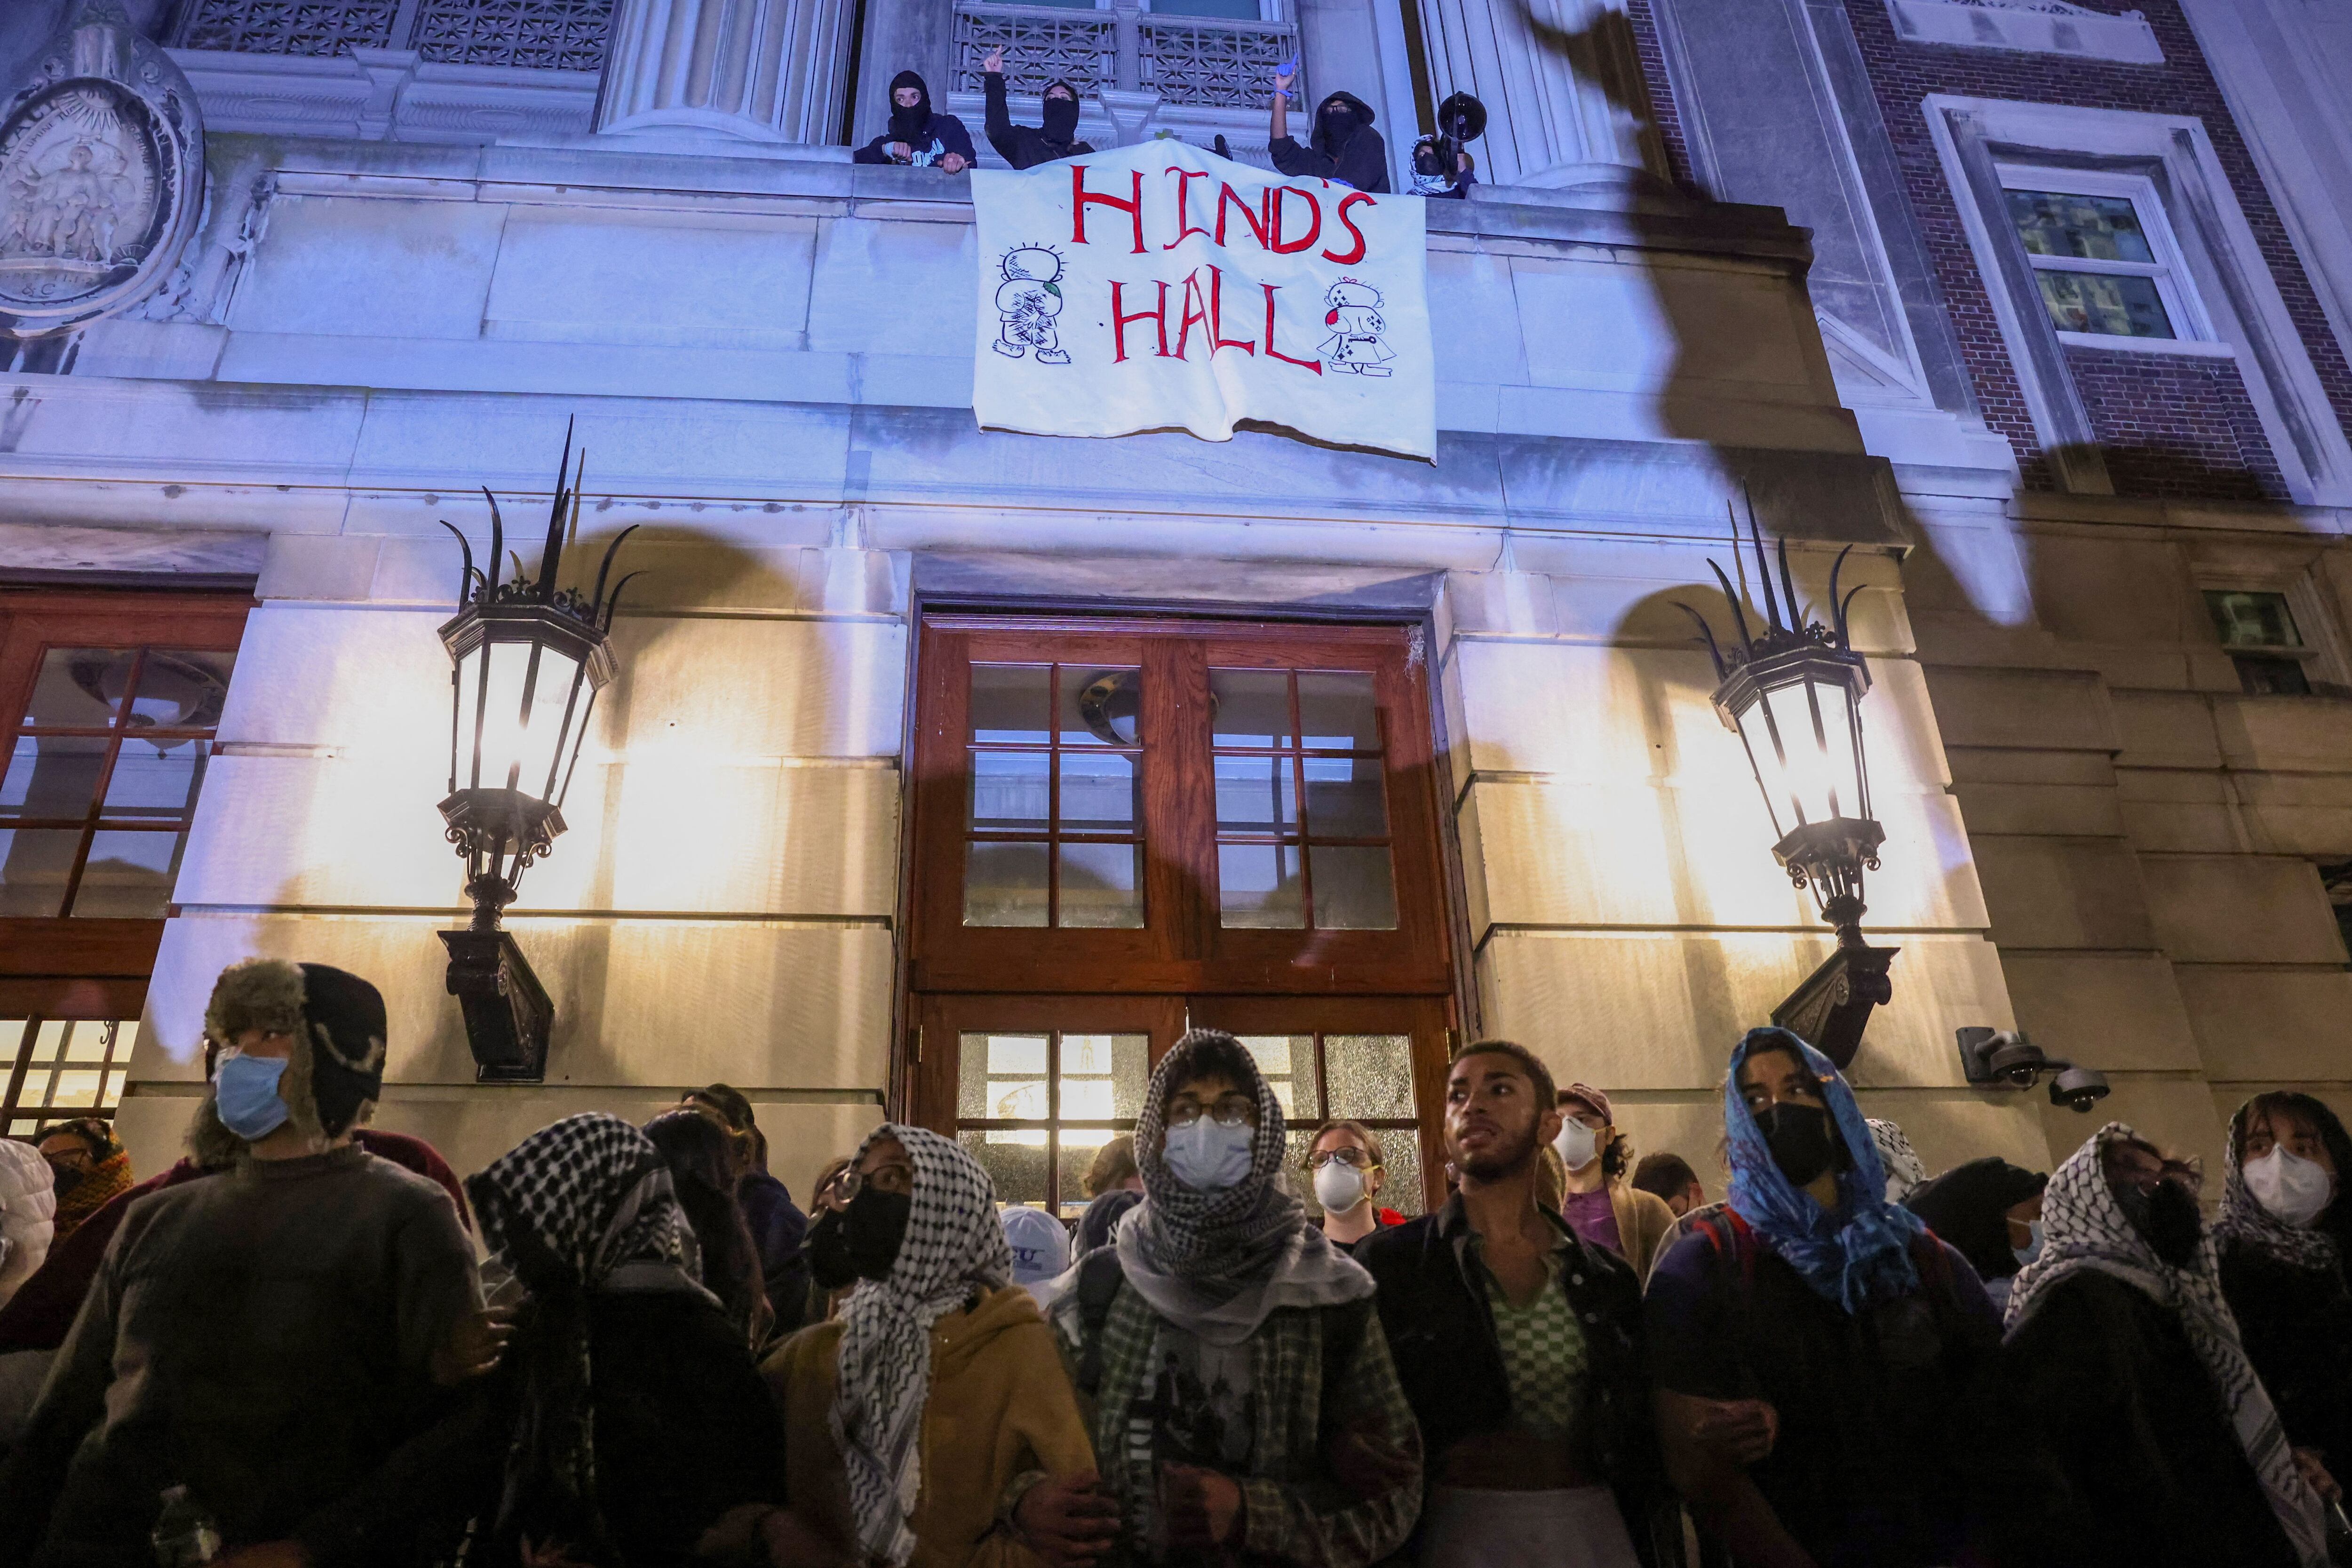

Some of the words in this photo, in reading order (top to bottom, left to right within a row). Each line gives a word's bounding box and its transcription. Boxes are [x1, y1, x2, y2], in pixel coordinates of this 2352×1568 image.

[19, 122, 56, 153] LUMINE
[127, 124, 153, 170] DEBIMUS
[1070, 165, 1378, 264] HIND'S
[1107, 264, 1322, 376] HALL
